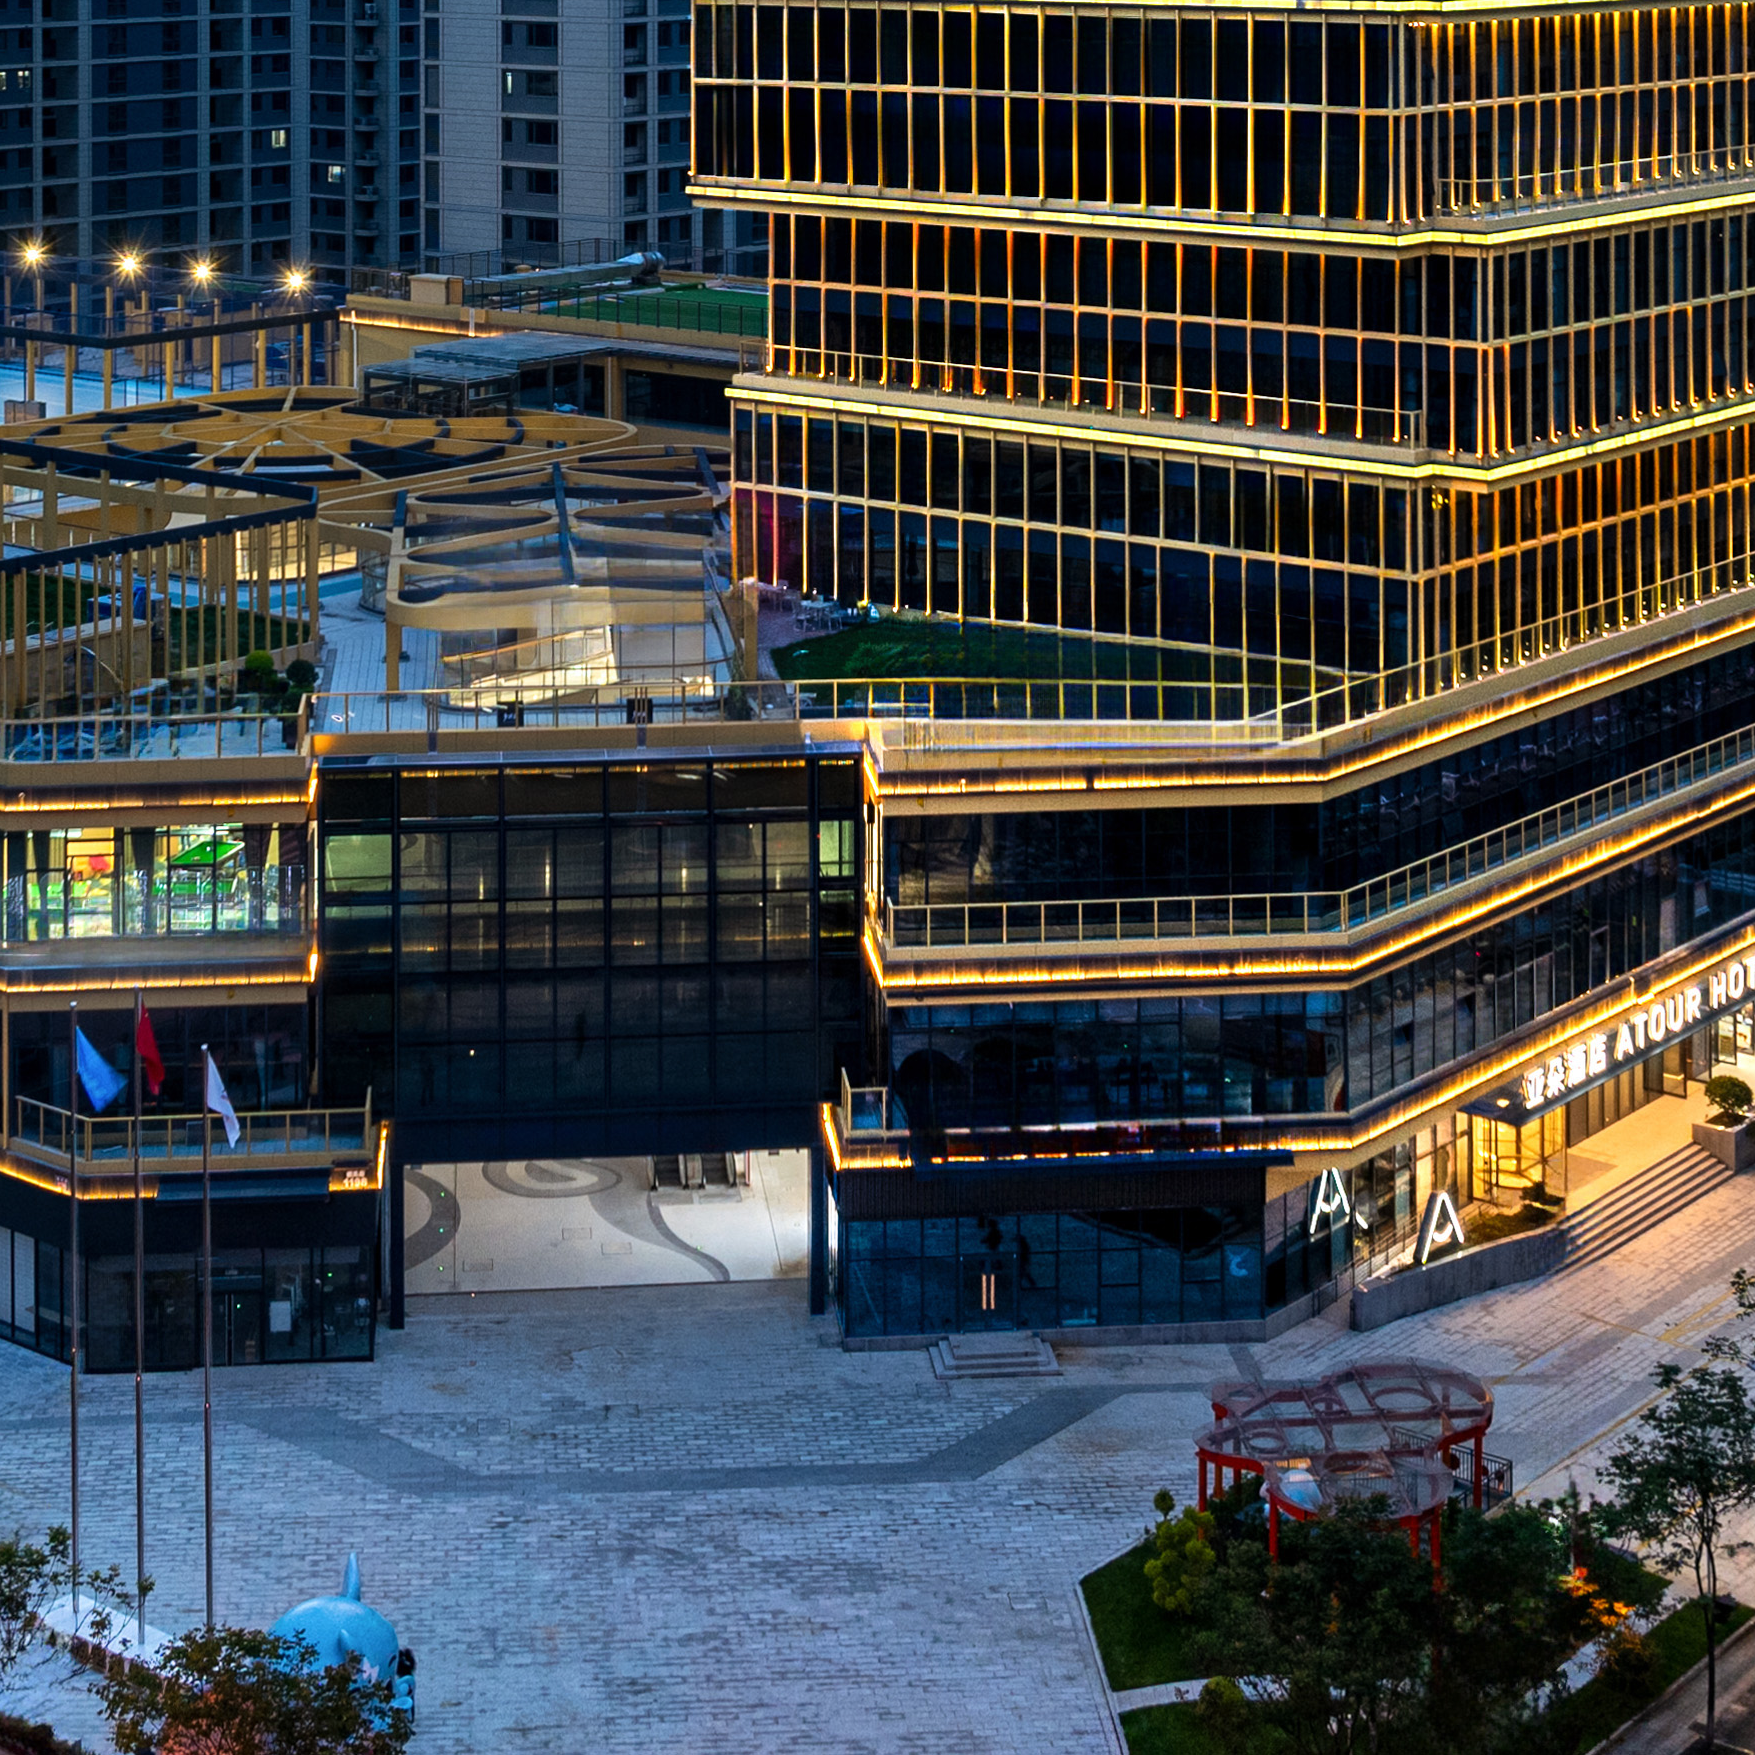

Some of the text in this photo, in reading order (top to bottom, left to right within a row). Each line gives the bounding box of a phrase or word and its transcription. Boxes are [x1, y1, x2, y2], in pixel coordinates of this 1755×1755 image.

[1614, 985, 1702, 1062] ATOUR
[1521, 1033, 1608, 1110] 亚朵酒店
